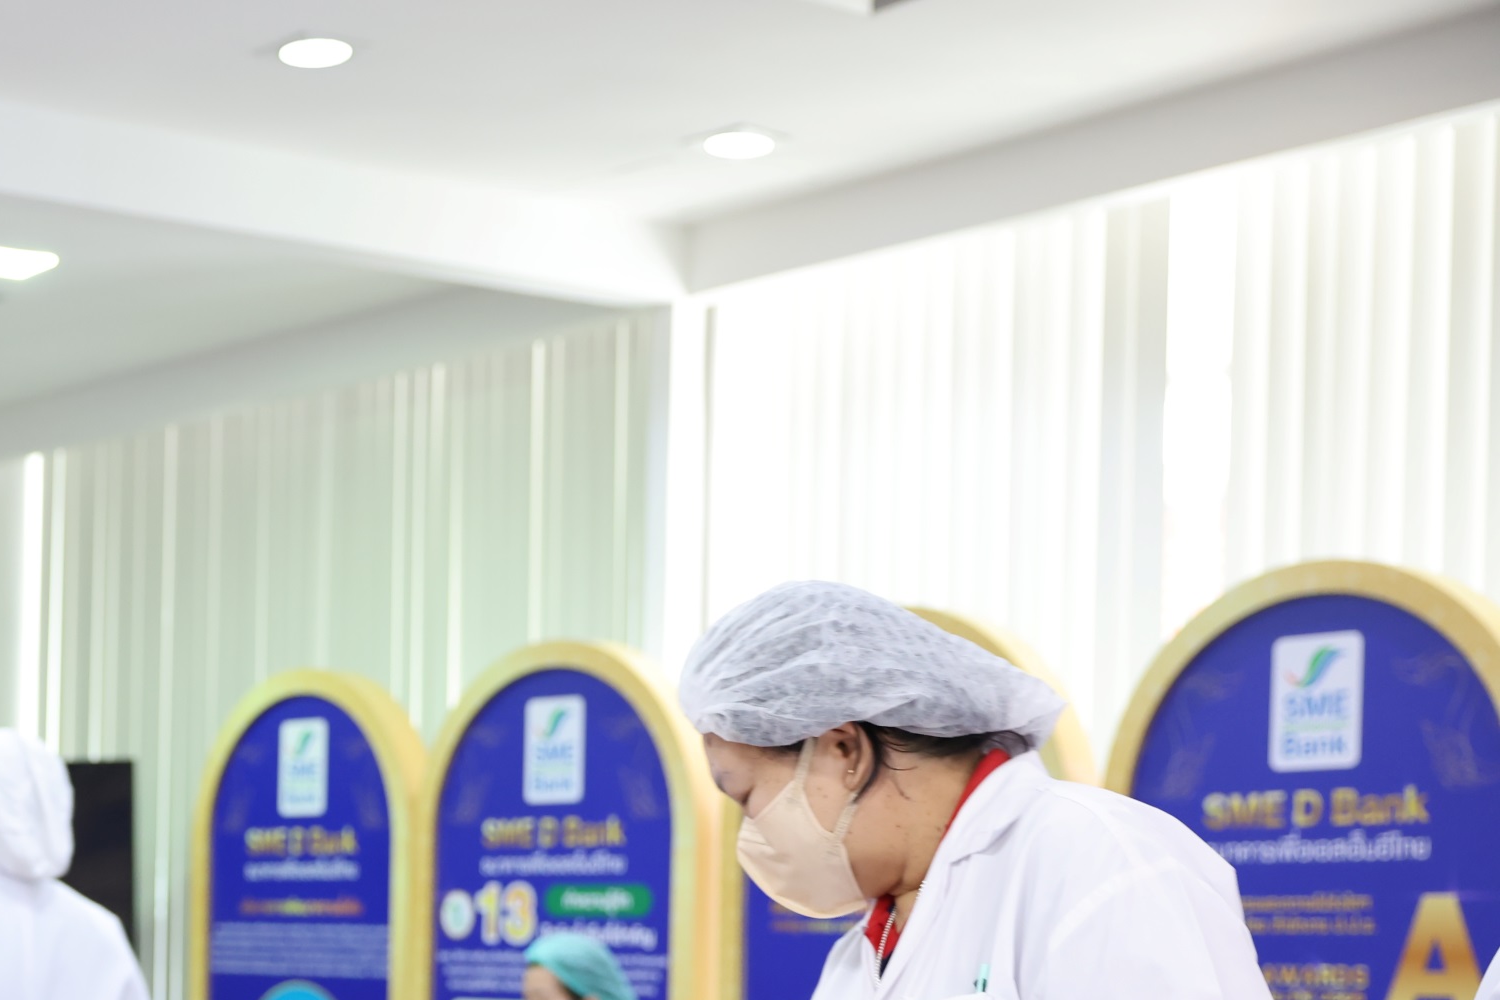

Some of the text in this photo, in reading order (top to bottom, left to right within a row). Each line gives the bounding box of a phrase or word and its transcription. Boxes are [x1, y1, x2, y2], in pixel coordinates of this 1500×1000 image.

[1286, 691, 1346, 717] SME
[1284, 734, 1346, 757] Bank
[1202, 784, 1430, 830] SME D Bank
[481, 817, 535, 849] SME
[562, 814, 627, 848] Bank
[476, 881, 538, 945] 13
